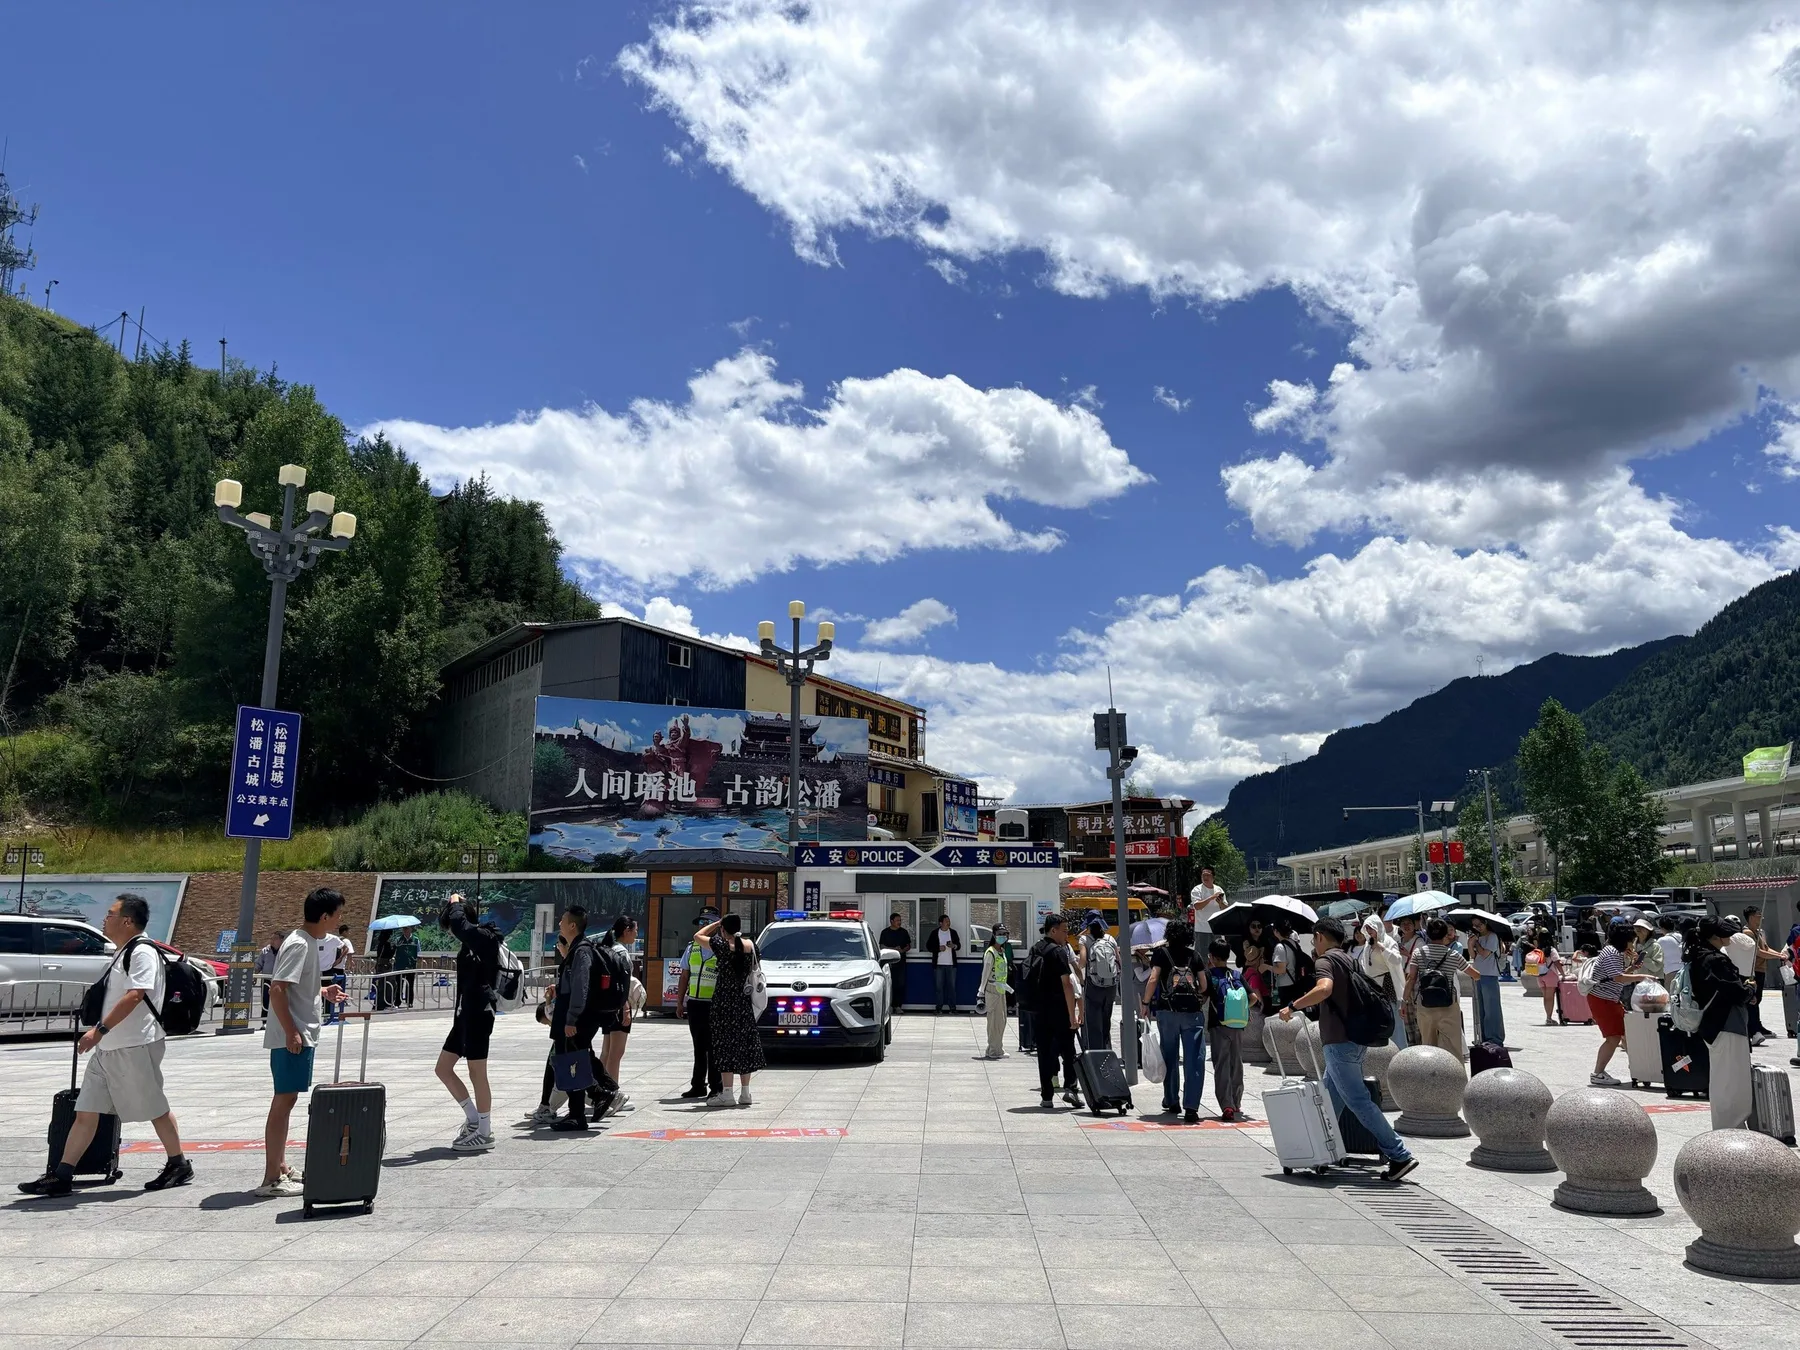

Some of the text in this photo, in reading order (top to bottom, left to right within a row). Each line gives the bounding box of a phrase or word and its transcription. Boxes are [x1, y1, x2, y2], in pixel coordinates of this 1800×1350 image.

[245, 717, 265, 787] 松潘古城
[270, 722, 288, 789] (松潘县城)
[565, 768, 698, 803] 人间瑶池
[236, 793, 289, 807] 公交乘车点
[1125, 843, 1160, 855] 树下烧
[800, 849, 843, 864] 公安
[861, 850, 904, 863] POLICE
[948, 849, 991, 865] 公安
[1009, 851, 1053, 864] POLICE
[742, 877, 770, 890] 旅游咨询
